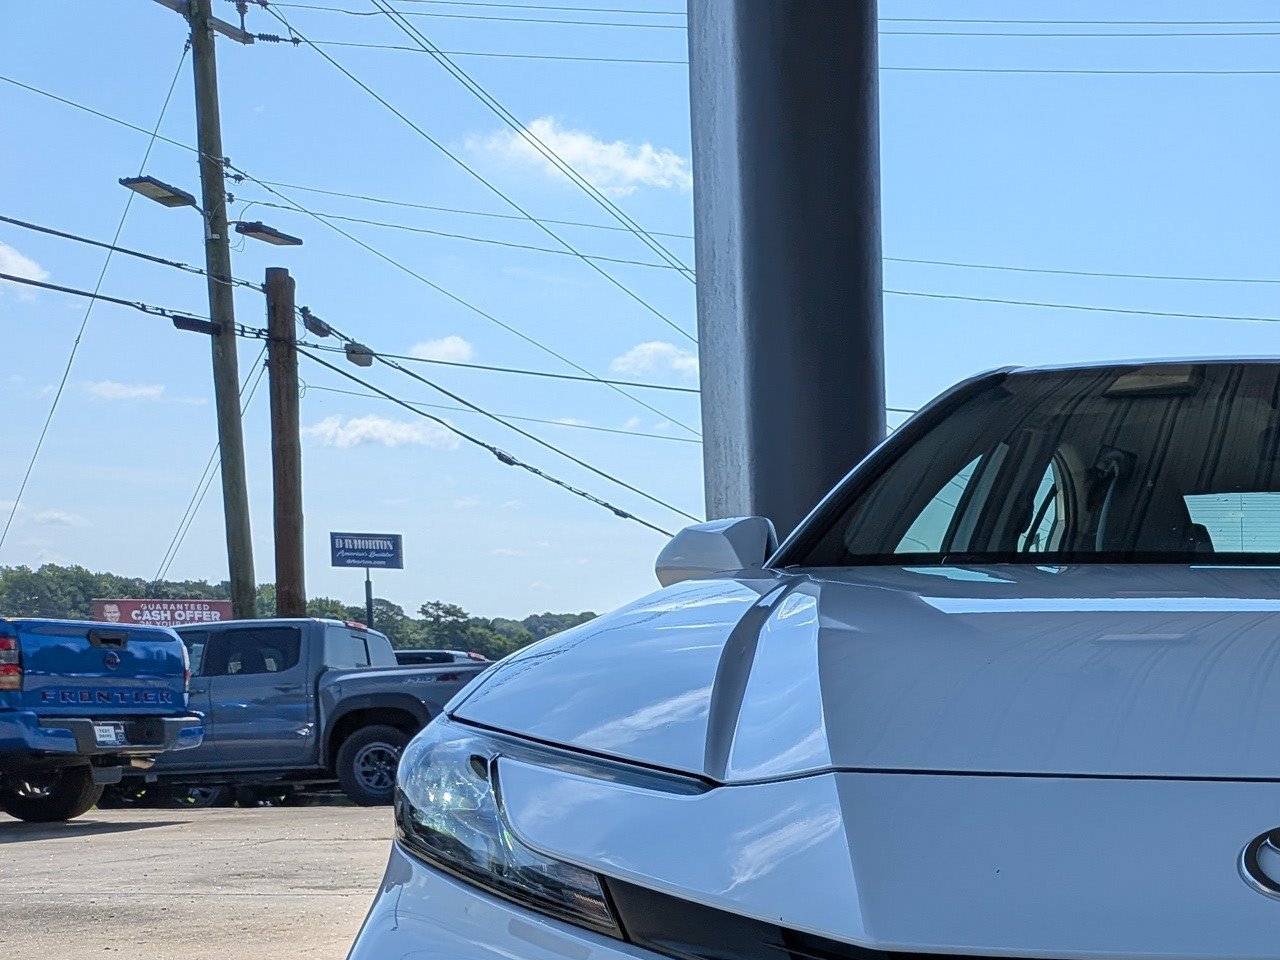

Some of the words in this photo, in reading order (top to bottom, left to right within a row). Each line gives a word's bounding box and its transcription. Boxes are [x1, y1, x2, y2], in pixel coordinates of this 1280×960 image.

[140, 603, 210, 611] GUARANTEED
[131, 609, 171, 621] CASH
[174, 610, 221, 621] OFFER
[40, 690, 173, 704] FRONTIER
